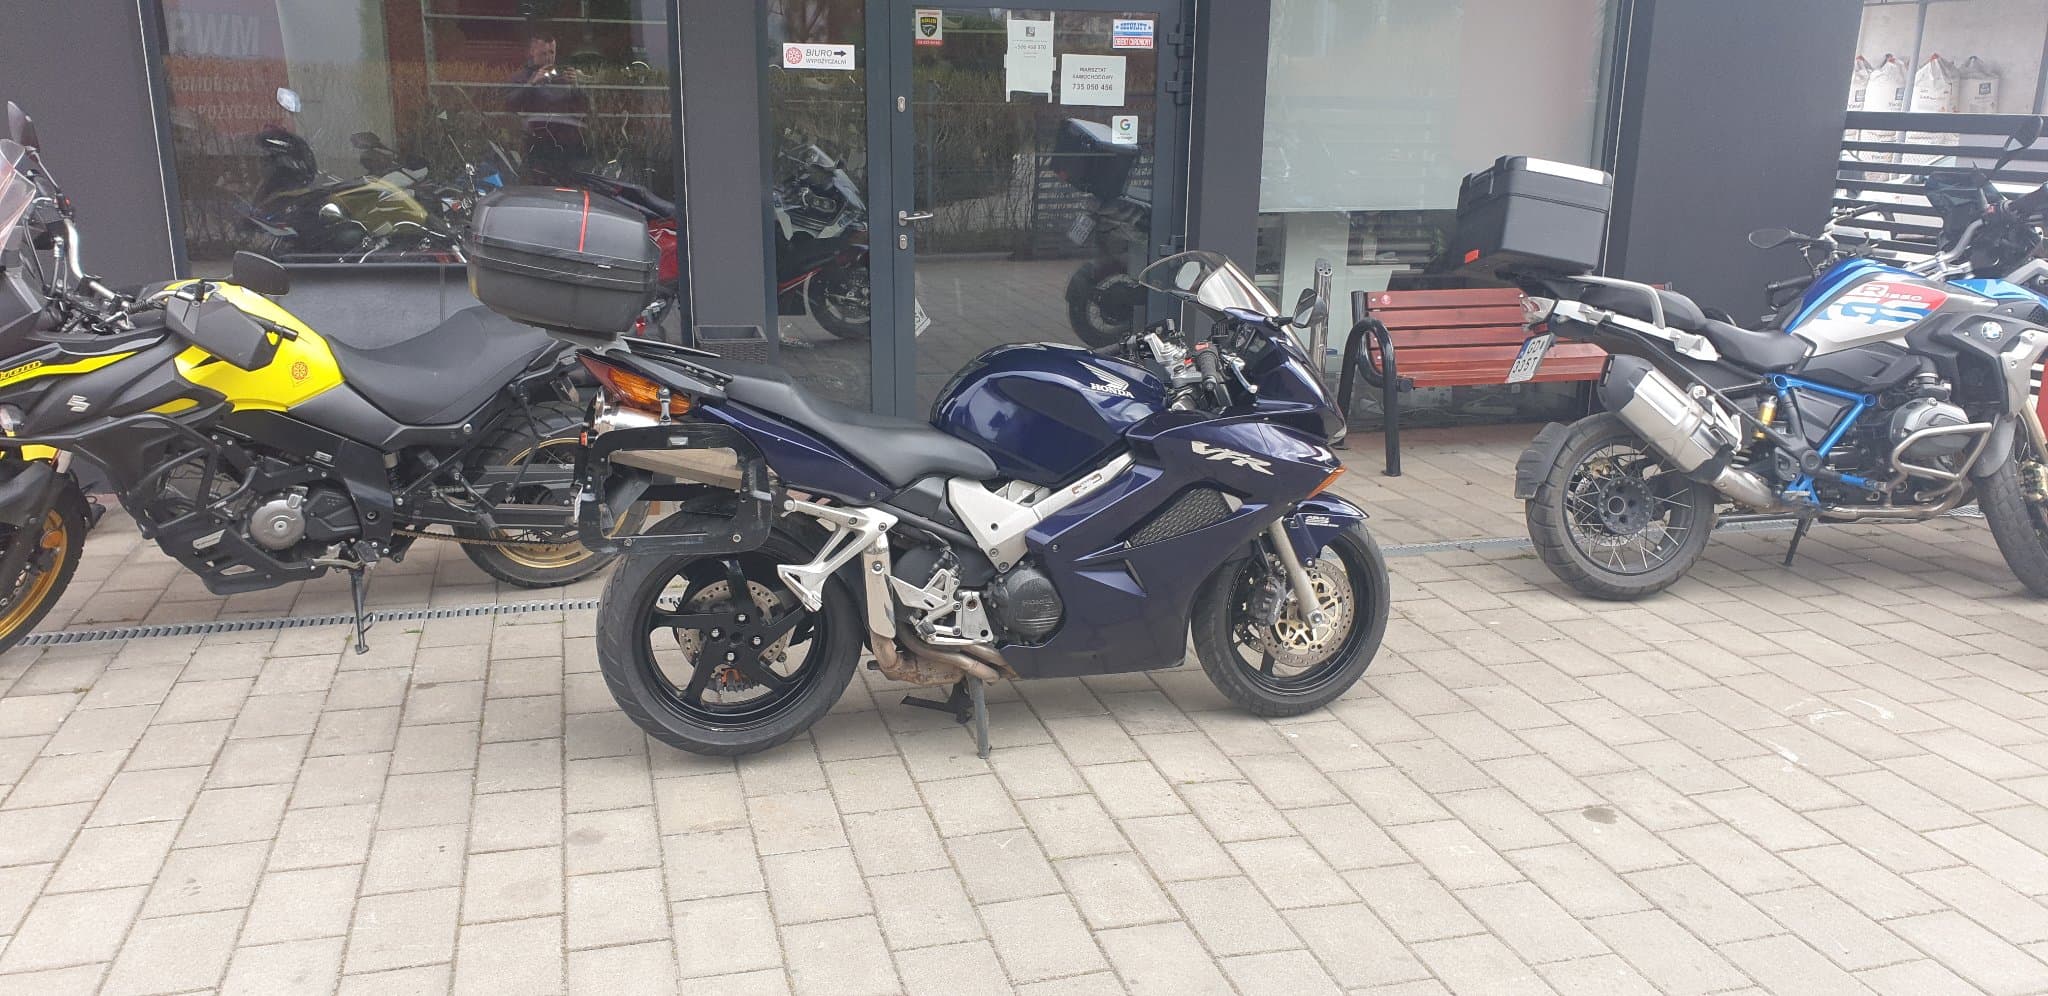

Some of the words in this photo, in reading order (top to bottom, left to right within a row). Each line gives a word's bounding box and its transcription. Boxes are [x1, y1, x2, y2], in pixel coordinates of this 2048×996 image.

[805, 48, 833, 57] BIURO
[1072, 83, 1085, 91] 735
[1089, 382, 1136, 400] HONDA
[1191, 440, 1275, 476] VFR
